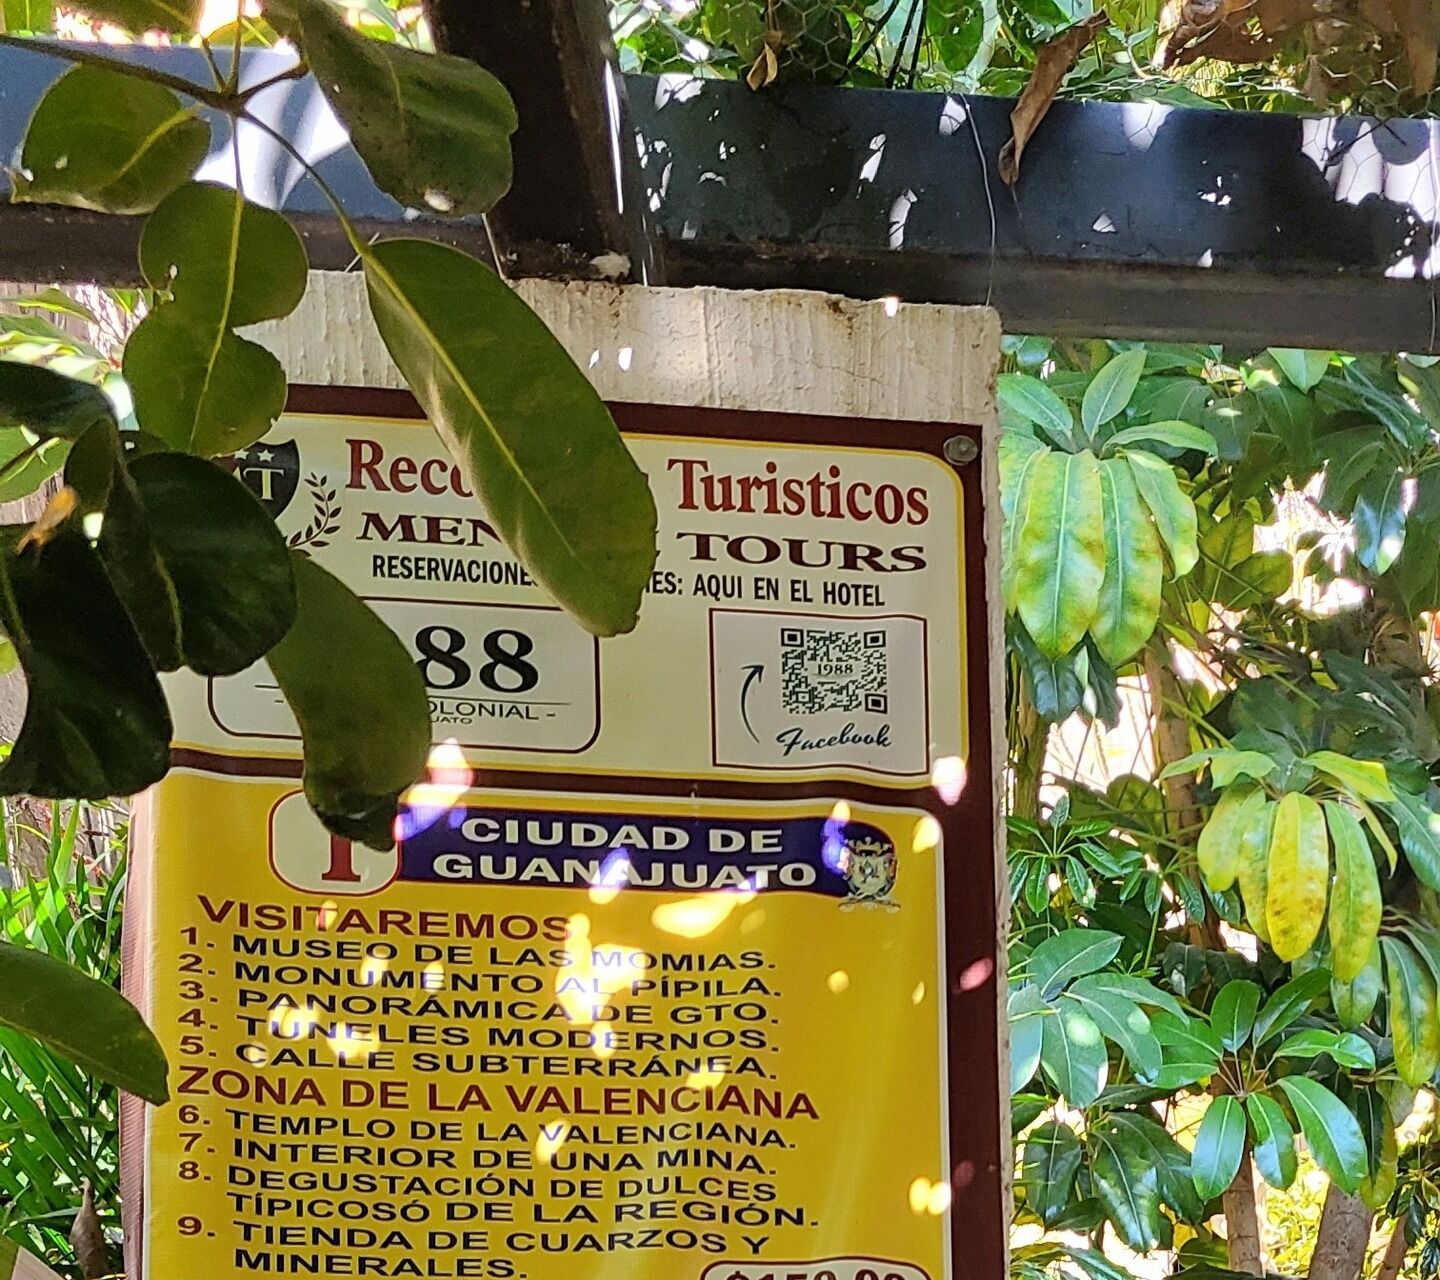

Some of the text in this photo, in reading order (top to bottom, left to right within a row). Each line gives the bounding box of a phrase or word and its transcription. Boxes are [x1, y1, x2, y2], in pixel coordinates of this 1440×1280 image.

[667, 459, 929, 525] Turisticos
[677, 532, 927, 572] TOURS
[372, 555, 538, 586] RESERVACIONE
[693, 574, 742, 600] AQUI
[754, 577, 779, 600] EN
[791, 580, 813, 602] EL
[823, 581, 885, 606] HOTEL
[817, 664, 853, 675] 1988
[776, 723, 892, 756] Facebook
[461, 818, 783, 853] CIUDAD DE
[433, 854, 816, 888] GUANAJUATO
[197, 895, 571, 941] VISITAREMOS
[180, 927, 776, 971] 1. MUSEO DE LAS MOMIAS.
[179, 981, 779, 1024] 3. PANORÁMICA DE GTO.
[179, 1036, 777, 1079] 5. CALLE SUBTERRÁNEA.
[177, 1066, 820, 1120] ZONA DE LA VALENCIANA
[179, 1132, 776, 1174] 7. INTERIOR DE UNA MINA.
